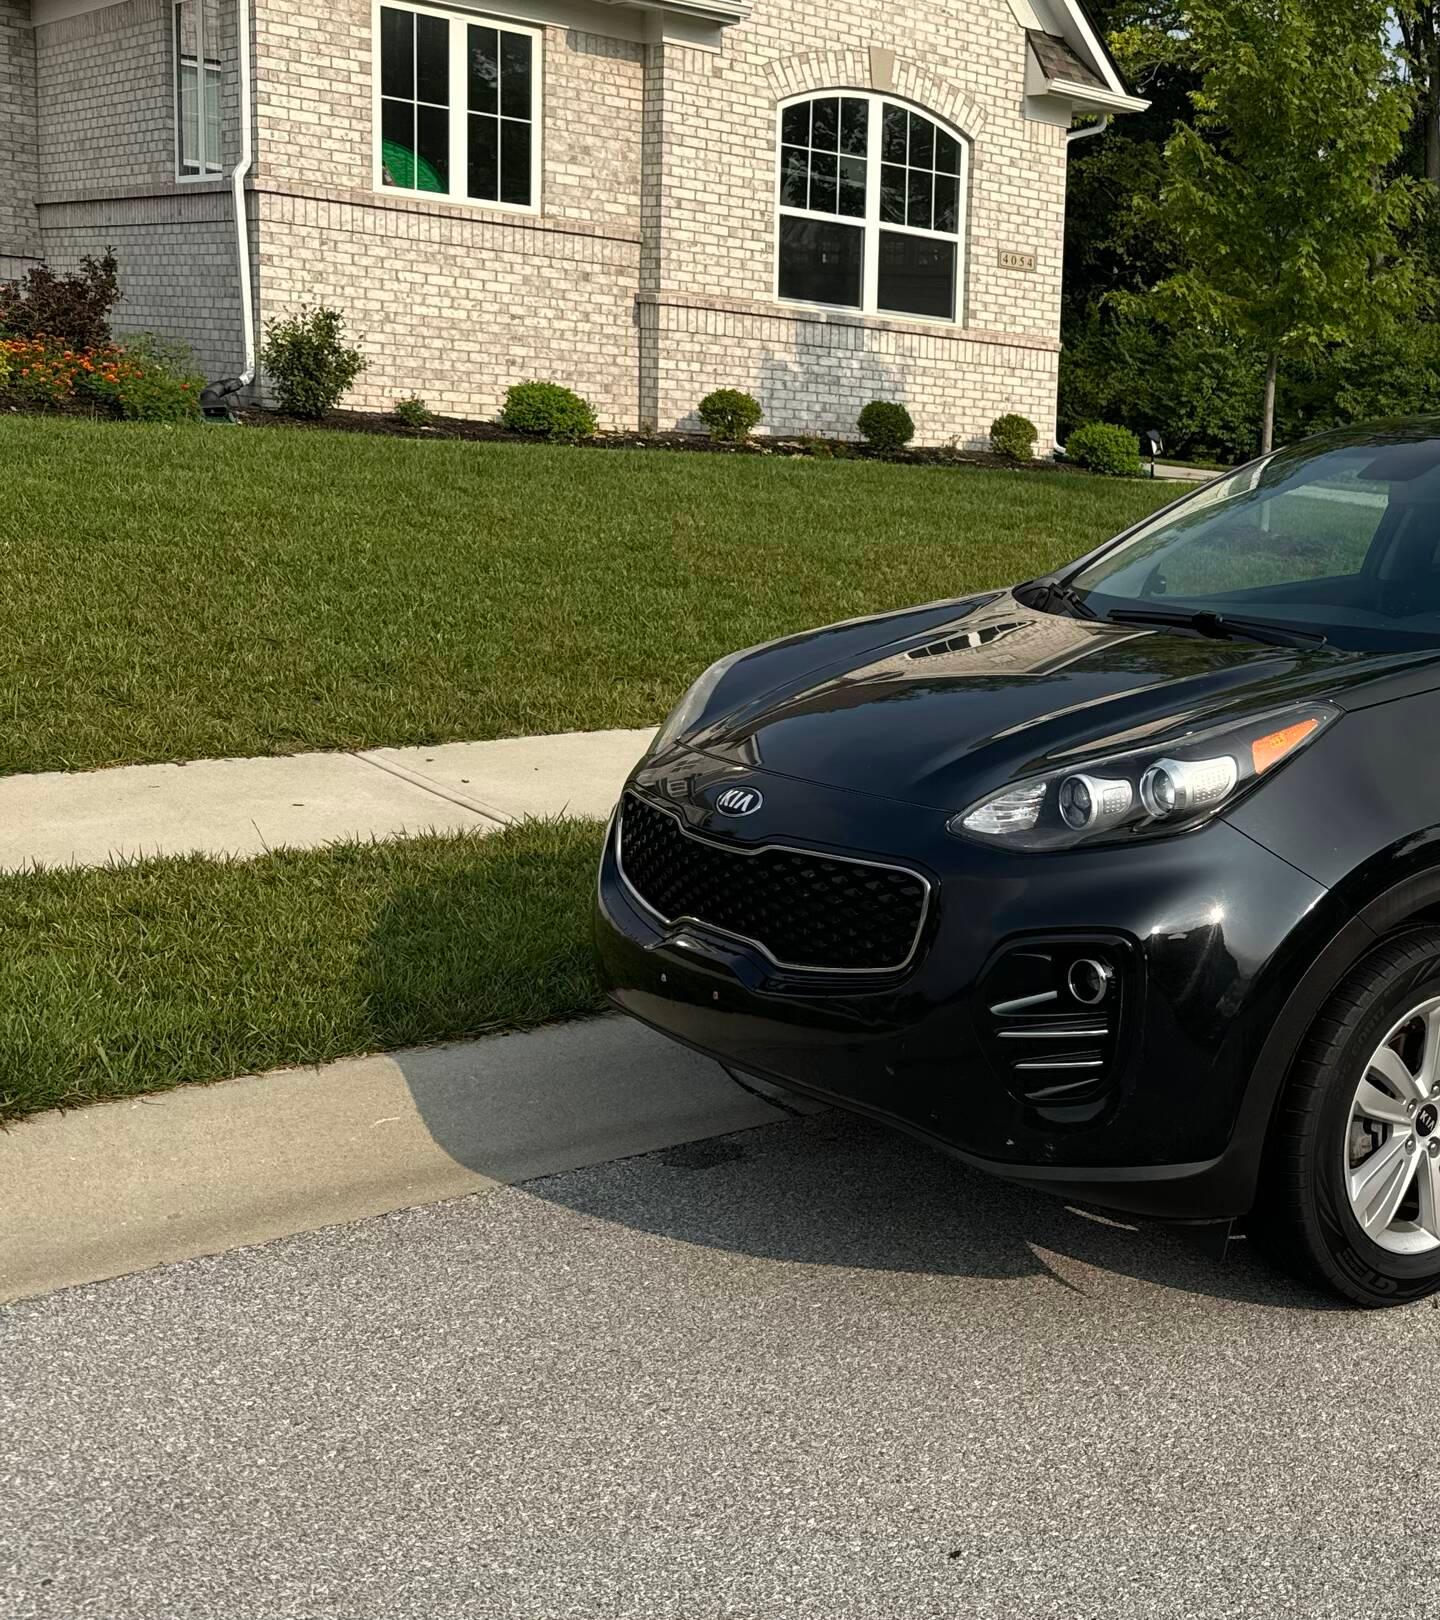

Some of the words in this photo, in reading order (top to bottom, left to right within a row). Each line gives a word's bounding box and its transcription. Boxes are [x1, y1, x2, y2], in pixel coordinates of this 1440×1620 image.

[1003, 253, 1033, 267] 4054
[719, 789, 754, 812] KIA
[1419, 1110, 1435, 1131] KIA
